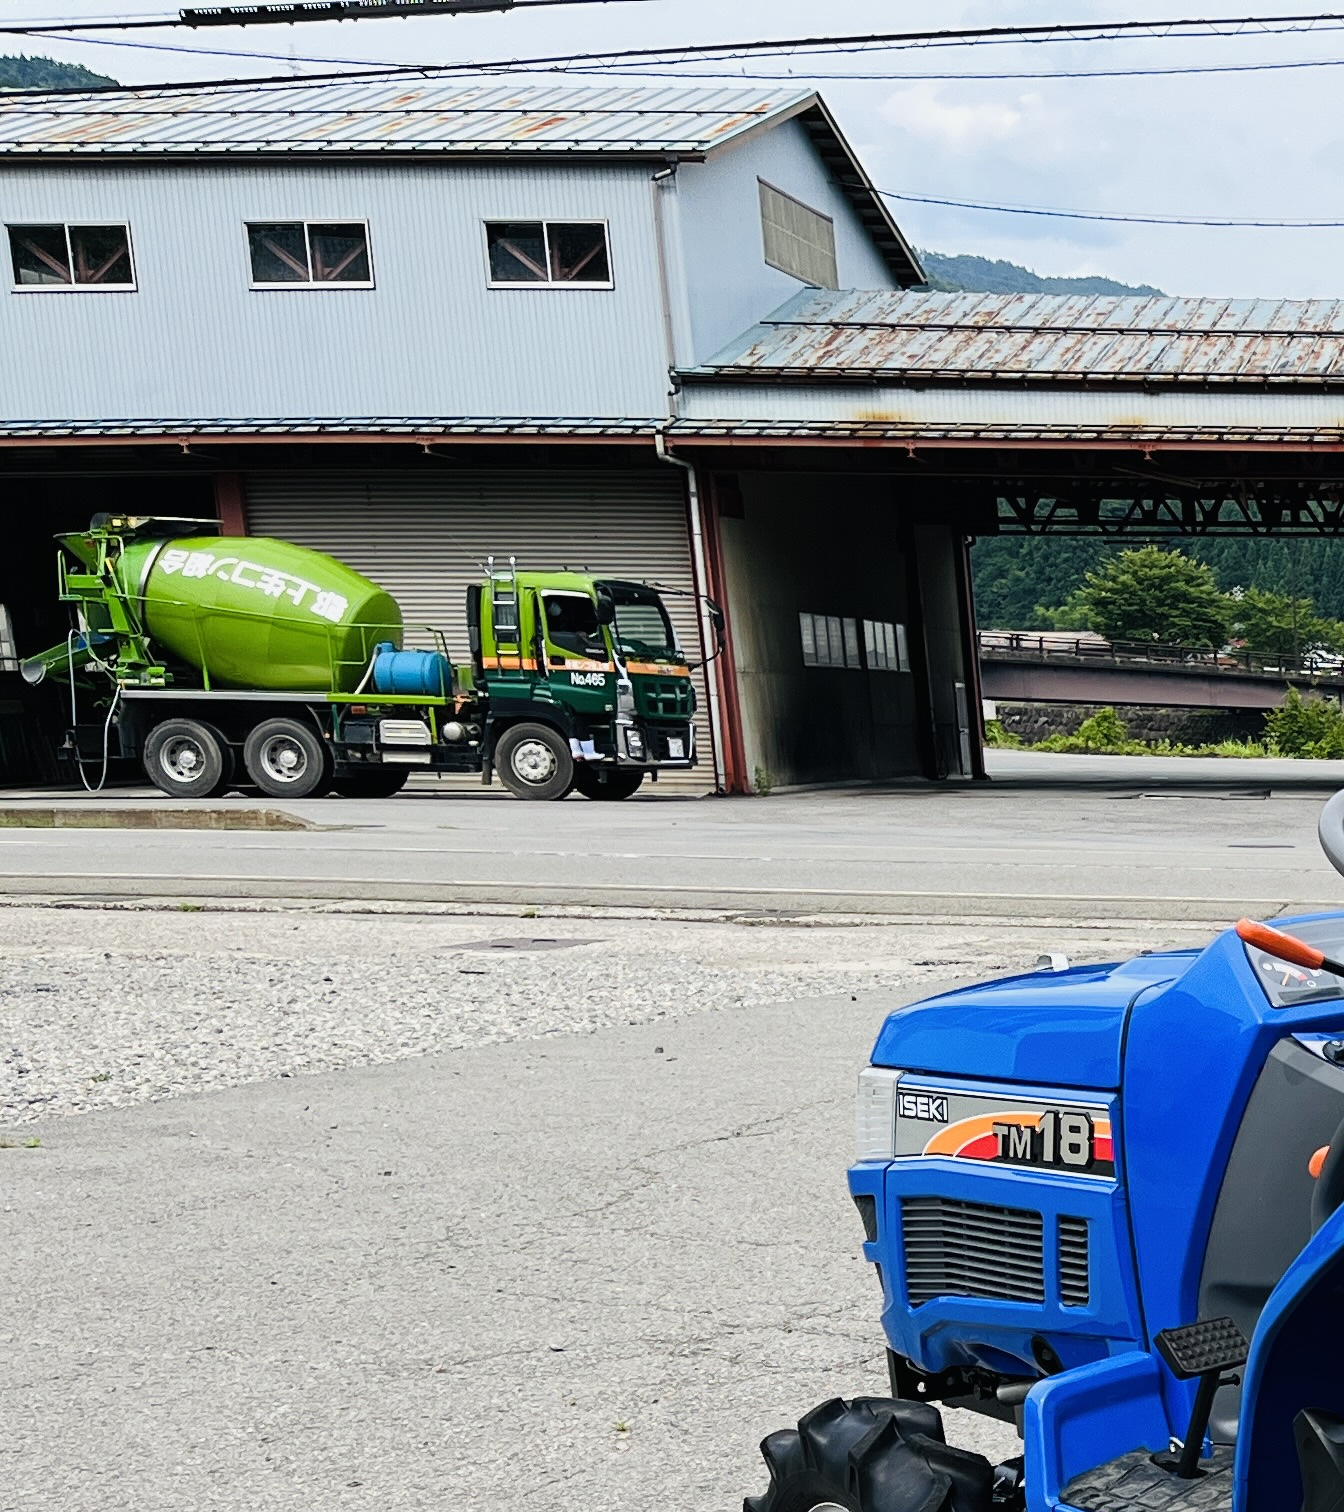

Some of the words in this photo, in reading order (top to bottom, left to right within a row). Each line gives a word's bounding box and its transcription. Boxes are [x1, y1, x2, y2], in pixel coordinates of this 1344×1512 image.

[158, 548, 350, 623] 郡上生コン組合
[897, 1093, 949, 1123] ISEKI
[992, 1110, 1095, 1166] TM18
